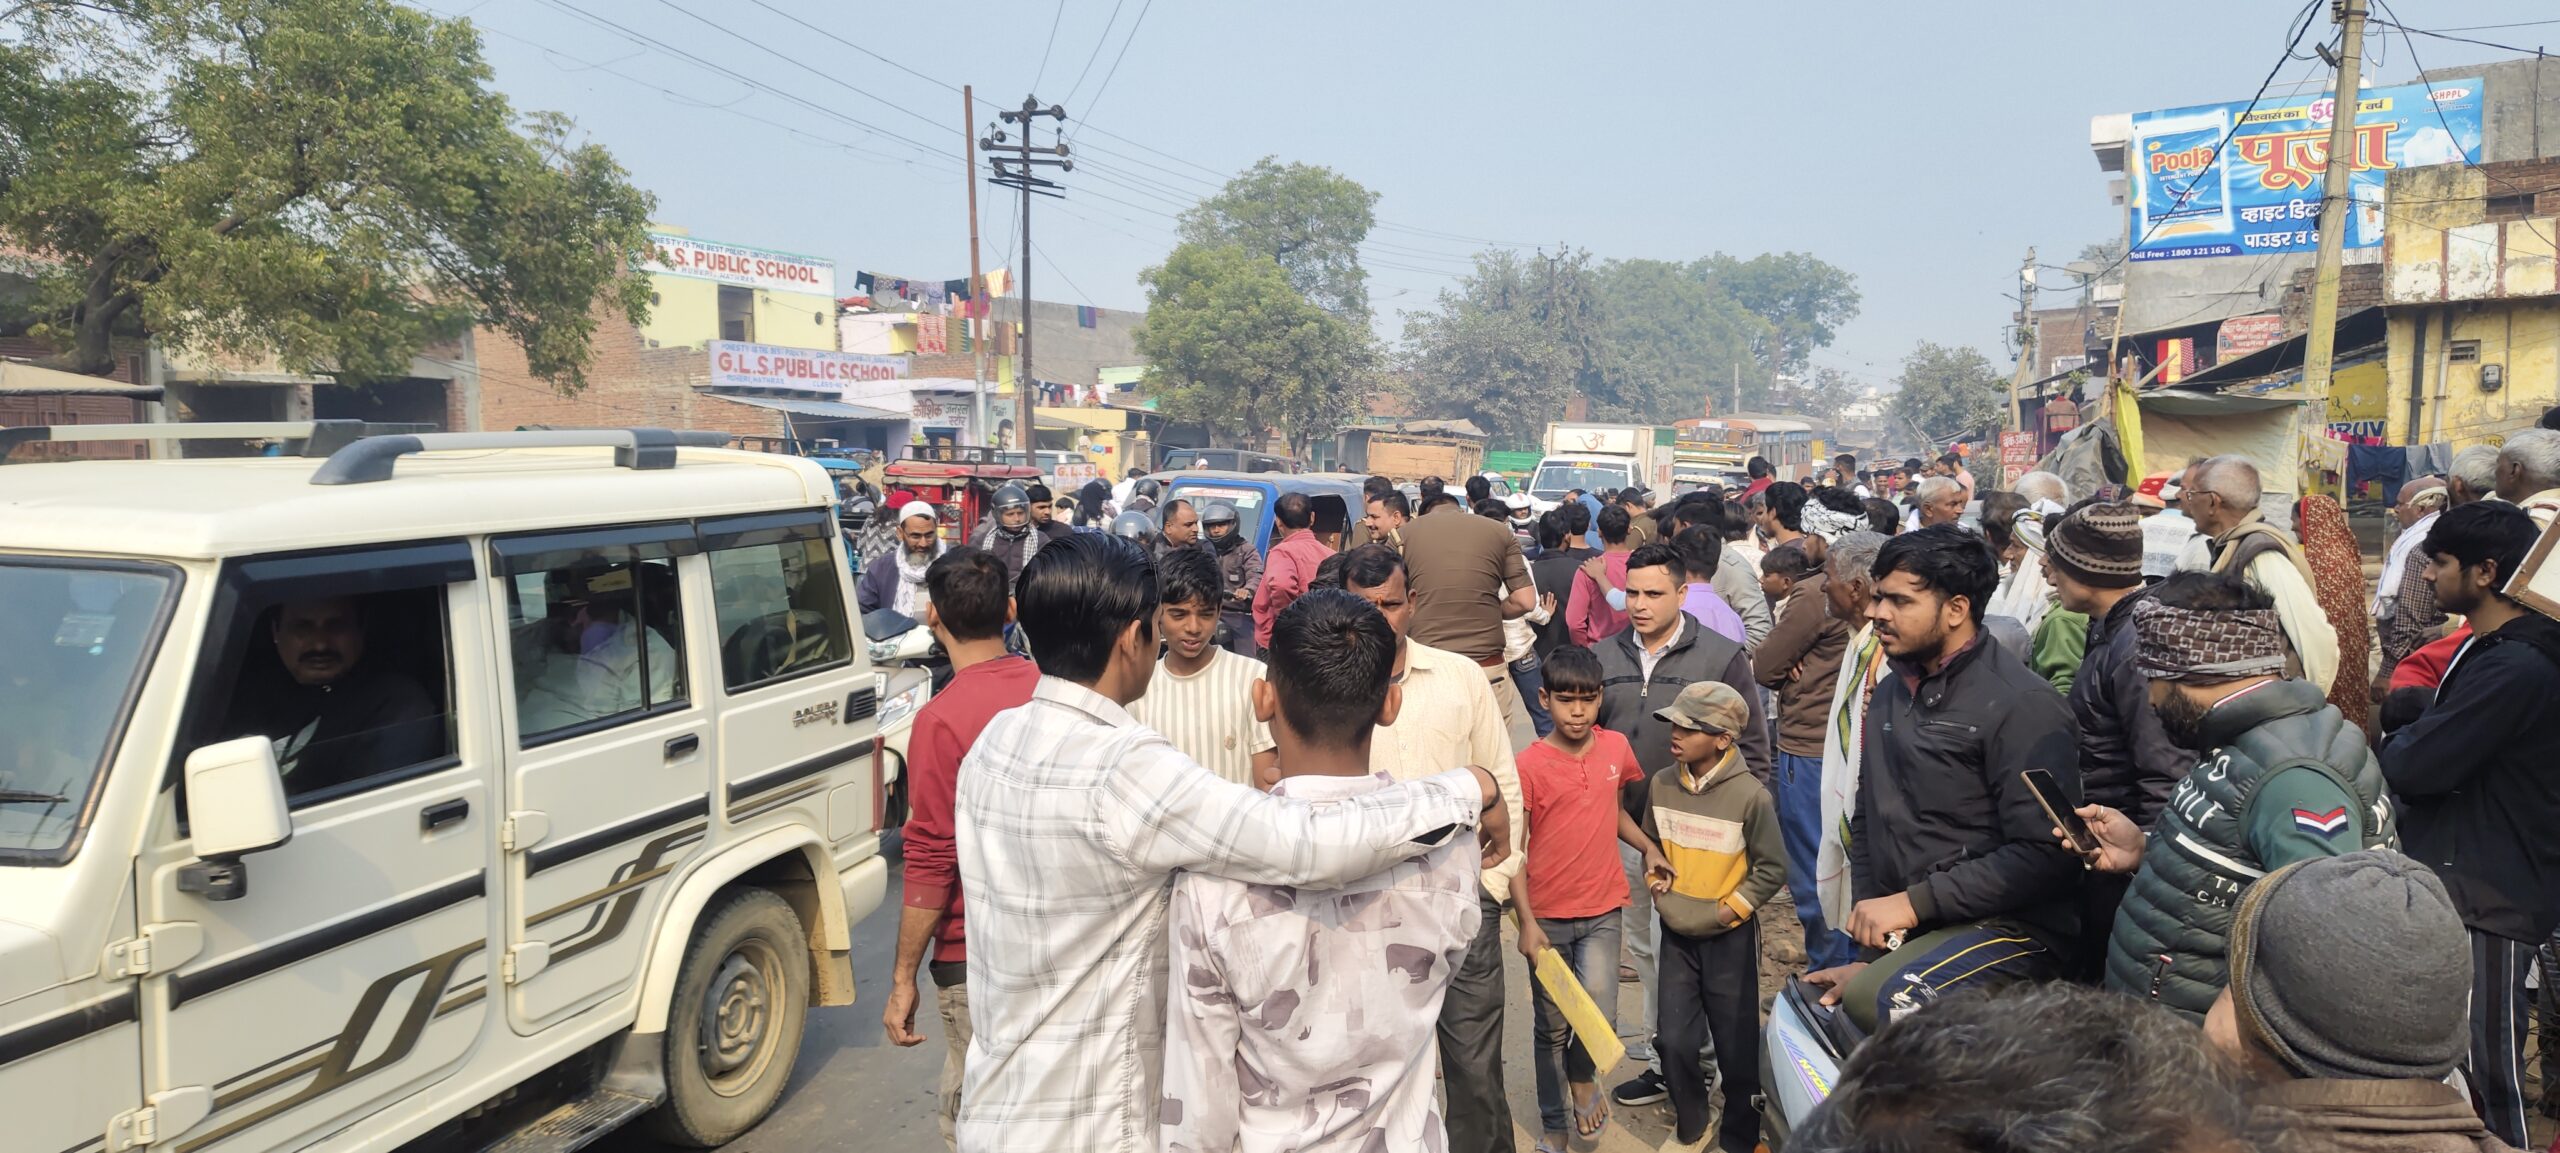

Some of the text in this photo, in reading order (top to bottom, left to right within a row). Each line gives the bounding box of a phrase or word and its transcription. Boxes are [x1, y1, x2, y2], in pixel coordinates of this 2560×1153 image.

[2434, 89, 2462, 100] SHPPL
[2284, 110, 2300, 119] का
[2365, 98, 2384, 111] वर्ष
[2151, 147, 2215, 173] Pooja
[2240, 204, 2287, 223] व्हाइट
[2244, 230, 2293, 248] पाउडर
[692, 242, 705, 250] THE
[707, 244, 723, 253] BEST
[725, 246, 748, 256] POLICY
[2130, 252, 2146, 260] Toll
[2147, 251, 2165, 259] Free
[2171, 249, 2191, 257] 1800
[2193, 247, 2208, 256] 121
[2211, 246, 2231, 255] 1626
[694, 250, 751, 275] PUBLIC
[756, 259, 819, 284] SCHOOL
[913, 398, 944, 419] कौशिक
[2328, 420, 2386, 438] RUV
